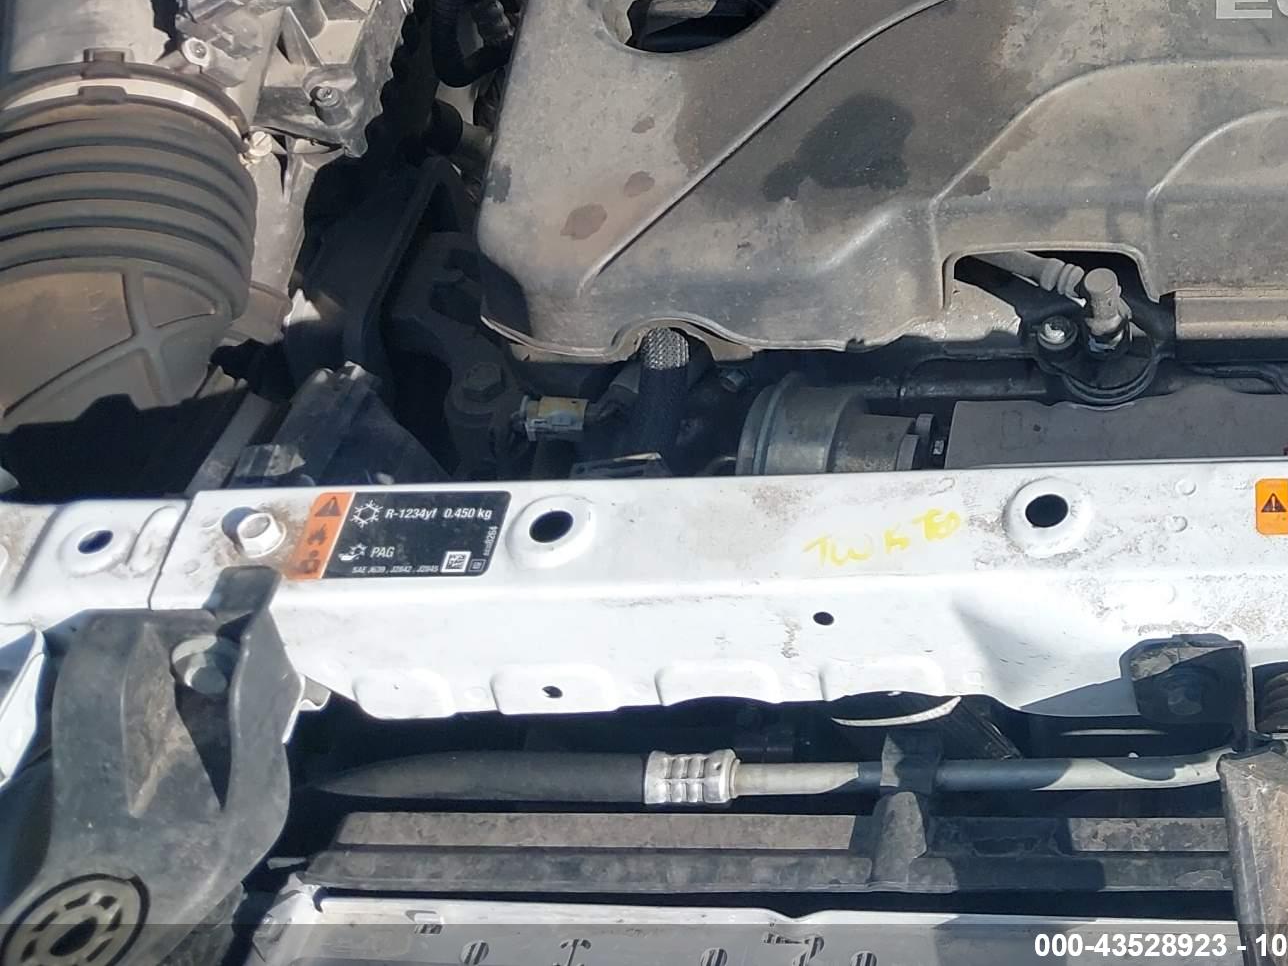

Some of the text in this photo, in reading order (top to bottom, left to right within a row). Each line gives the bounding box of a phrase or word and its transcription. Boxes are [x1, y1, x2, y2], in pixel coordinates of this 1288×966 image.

[384, 507, 493, 520] R-1234yf 0.450 kg
[370, 546, 395, 558] PAG
